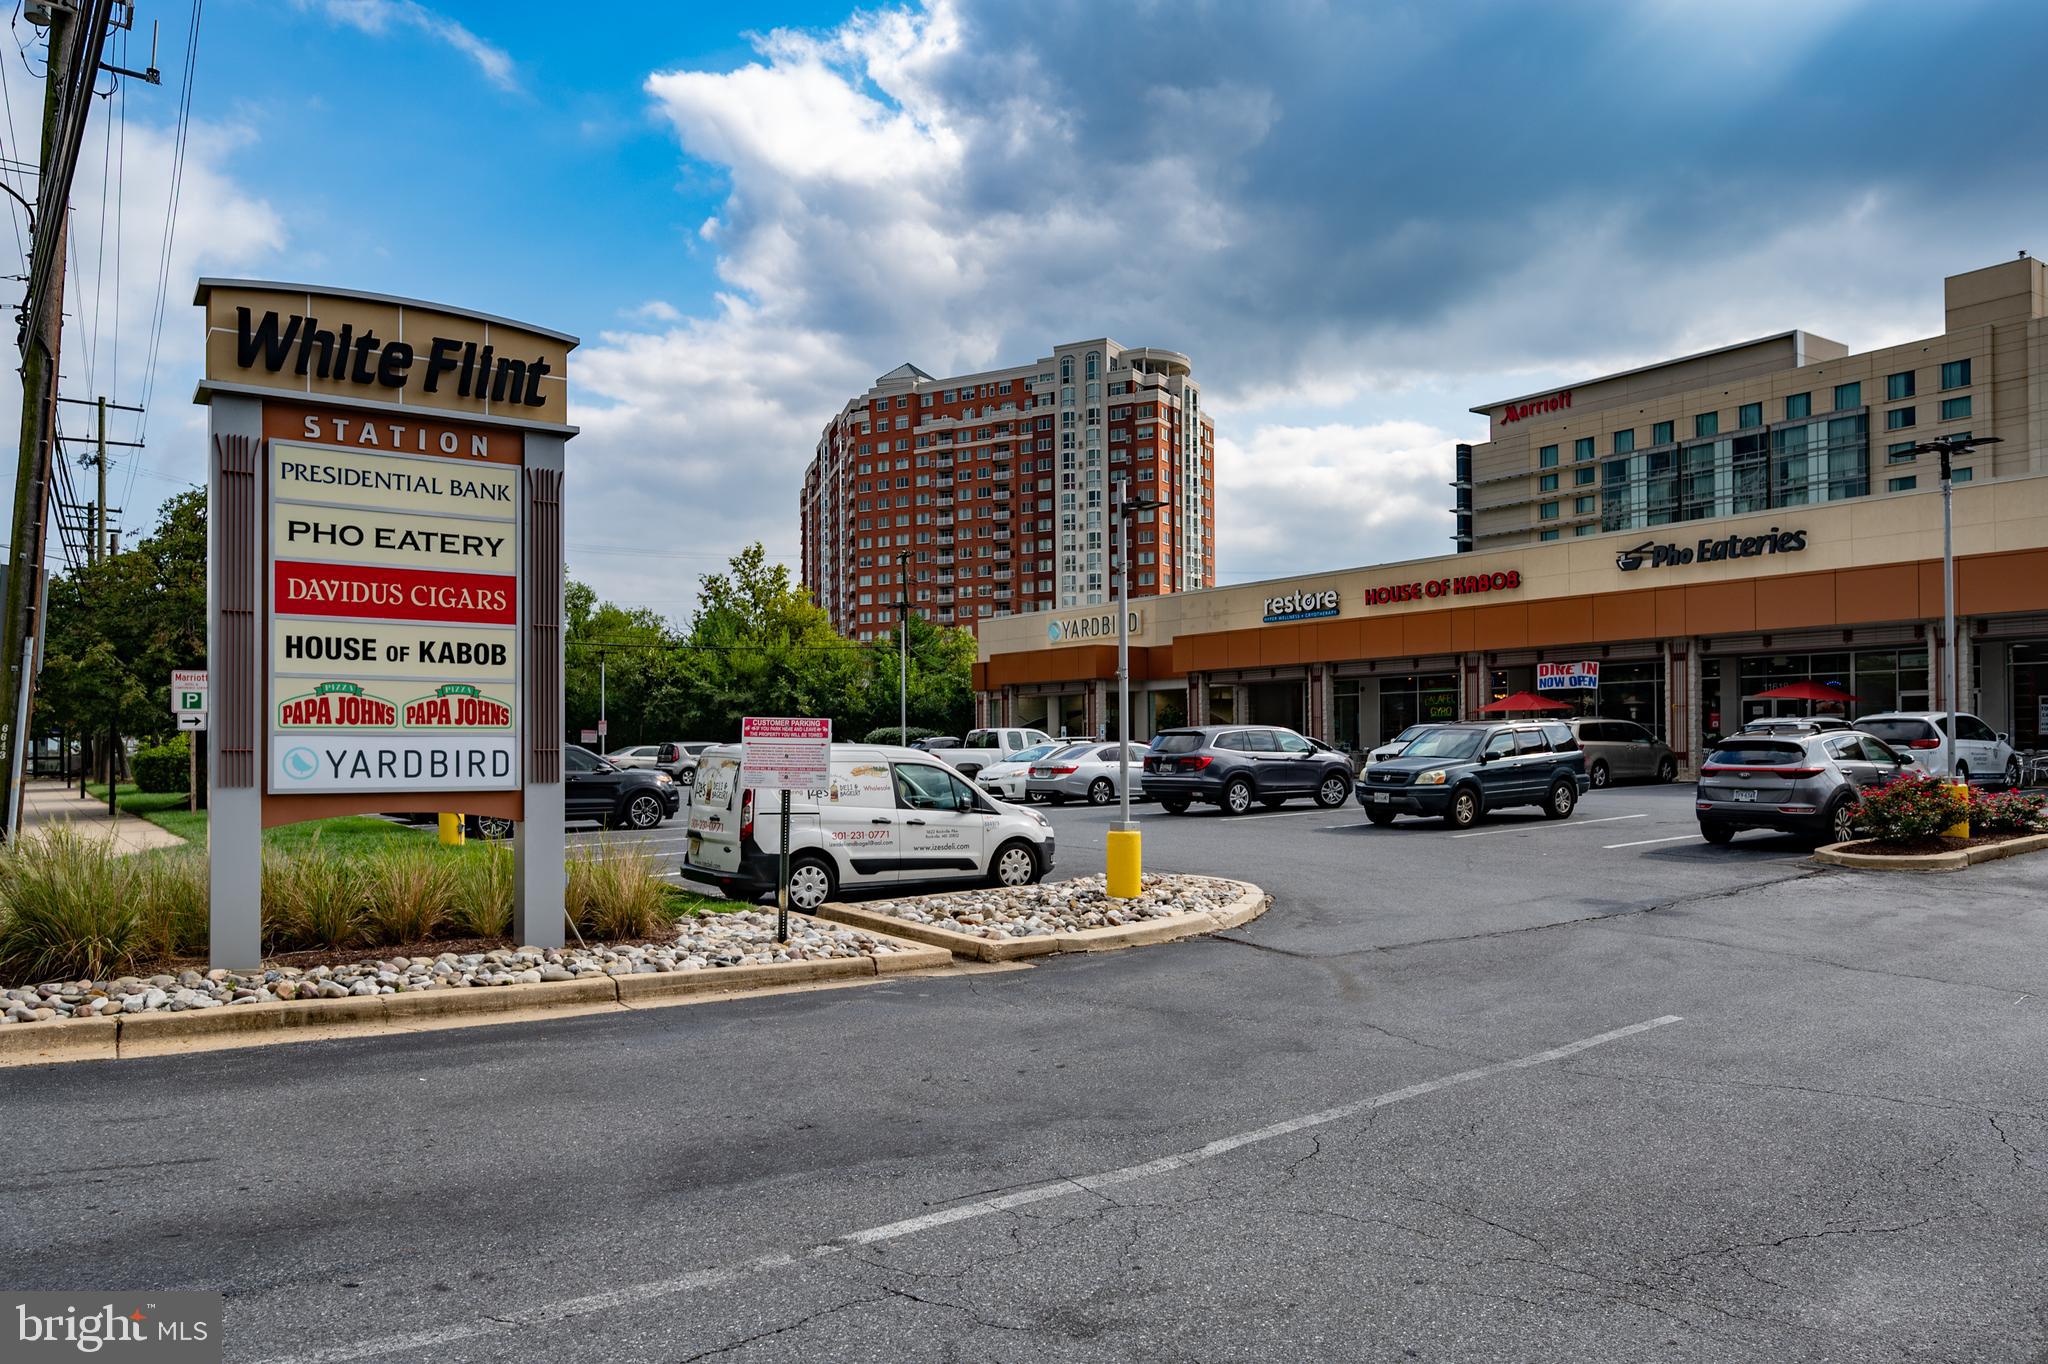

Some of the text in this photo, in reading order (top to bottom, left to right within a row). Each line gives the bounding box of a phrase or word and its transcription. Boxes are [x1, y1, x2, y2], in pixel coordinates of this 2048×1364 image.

[236, 306, 551, 407] White Flint
[1500, 391, 1571, 425] Marriott
[303, 416, 488, 457] STATION
[281, 461, 511, 501] PRESIDENTIAL BANK
[288, 520, 504, 557] PHO EATERY
[1652, 527, 1806, 567] Pho Eateries
[288, 578, 506, 611] DAVIDUS CIGARS
[1264, 589, 1337, 614] restore
[1365, 570, 1520, 605] HOUSE OF KABOB
[1062, 612, 1137, 639] YARDBID
[285, 635, 506, 666] HOUSE OF KABOB
[1539, 661, 1597, 677] DINE IN
[1539, 675, 1597, 688] NOW OPEN
[324, 684, 354, 692] PIZZA
[445, 686, 473, 694] PIZZA
[282, 696, 394, 725] PAPA JOHN'S
[406, 698, 509, 725] PAPA JOHN'S
[326, 750, 509, 778] YARDBIRD
[832, 831, 889, 840] 301-231-0771
[913, 842, 970, 852] www.izesdeli.com
